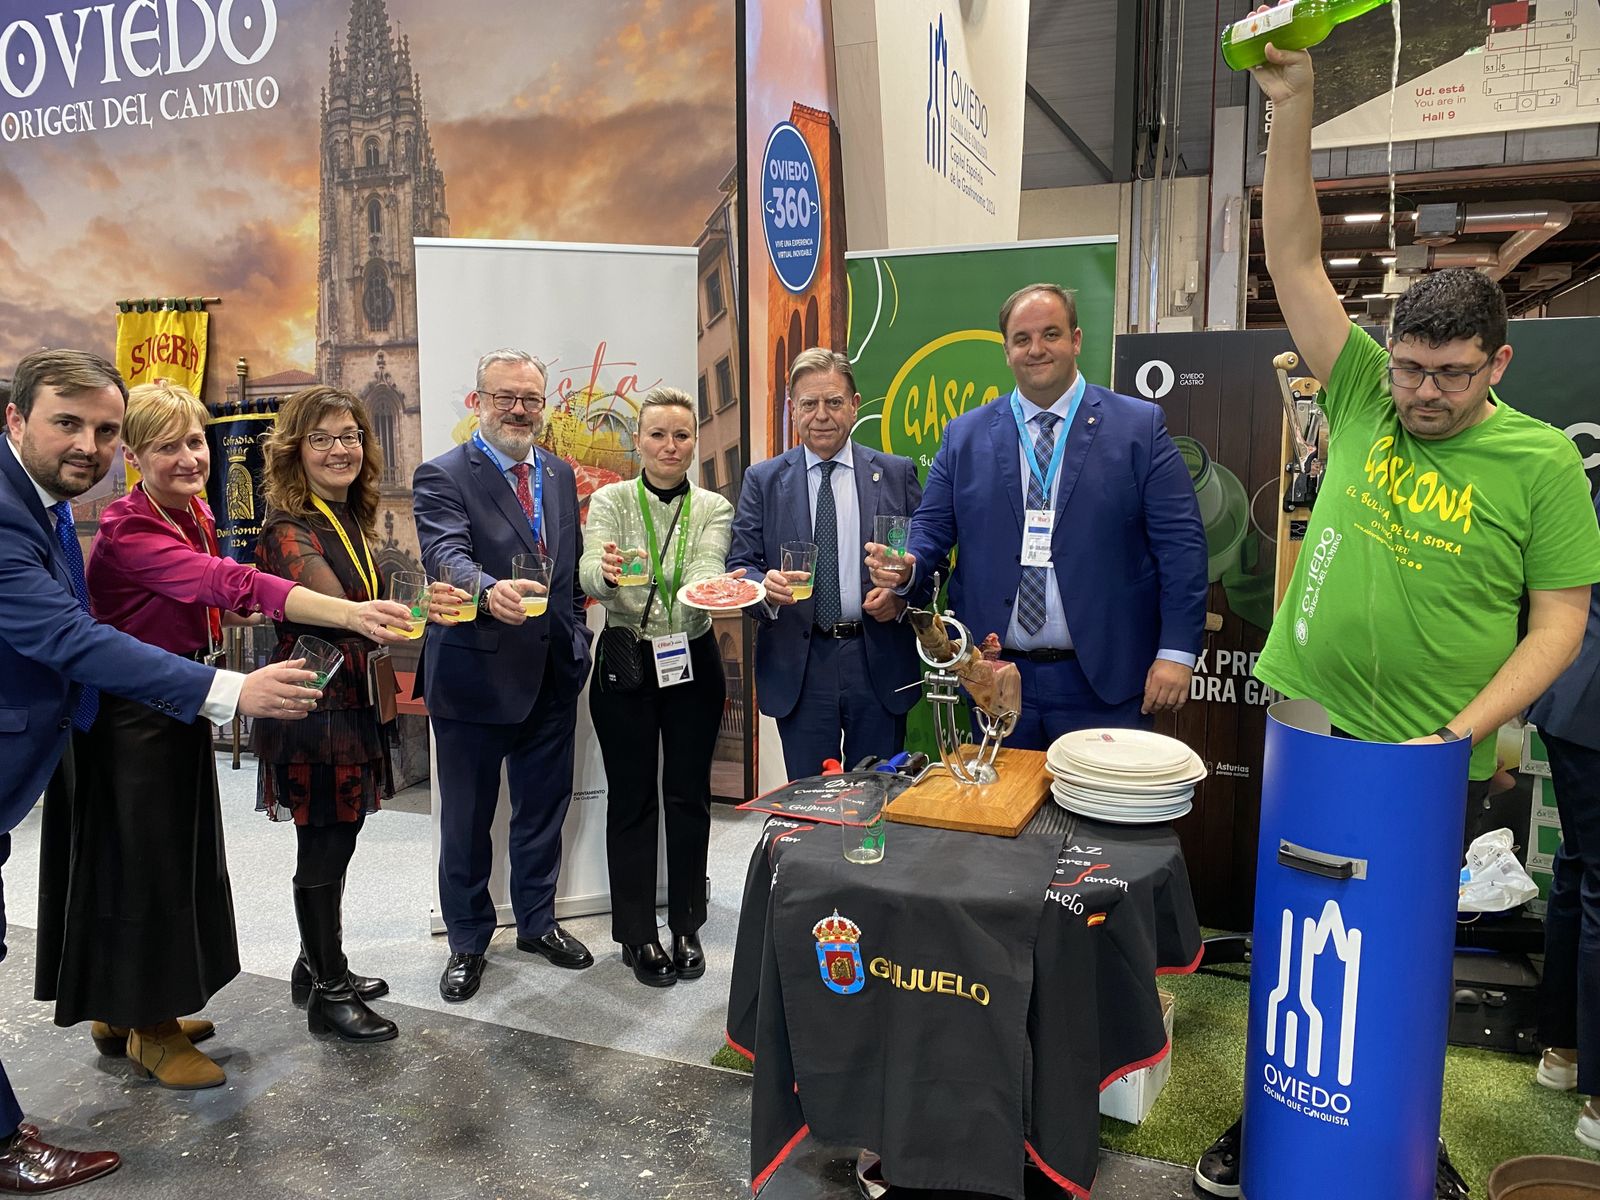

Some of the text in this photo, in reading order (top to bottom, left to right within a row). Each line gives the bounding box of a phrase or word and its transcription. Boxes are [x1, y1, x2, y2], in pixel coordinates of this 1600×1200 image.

[0, 0, 278, 98] OVIEDO
[1, 75, 280, 142] ORIGEN DEL CAMINO
[950, 69, 988, 138] OVIEDO
[1414, 95, 1467, 108] You are in
[1415, 84, 1465, 97] Ud. está
[1422, 110, 1456, 122] Hall 9
[769, 158, 810, 182] OVIEDO
[950, 144, 966, 171] Capital
[772, 187, 811, 229] 360
[1364, 435, 1473, 535] GASCONA
[1345, 485, 1357, 498] EL
[1390, 522, 1403, 536] DE
[1403, 529, 1420, 543] LA
[1422, 534, 1463, 556] SIDRA
[1301, 526, 1336, 613] OVIEDO
[1317, 569, 1328, 586] DEL
[1323, 533, 1343, 569] CAMINO
[1216, 761, 1250, 773] Asturias
[868, 956, 991, 1006] GUIJUELO
[1263, 1063, 1352, 1115] OVIEDO
[1263, 1083, 1286, 1105] COCINA
[1286, 1098, 1302, 1113] QUE
